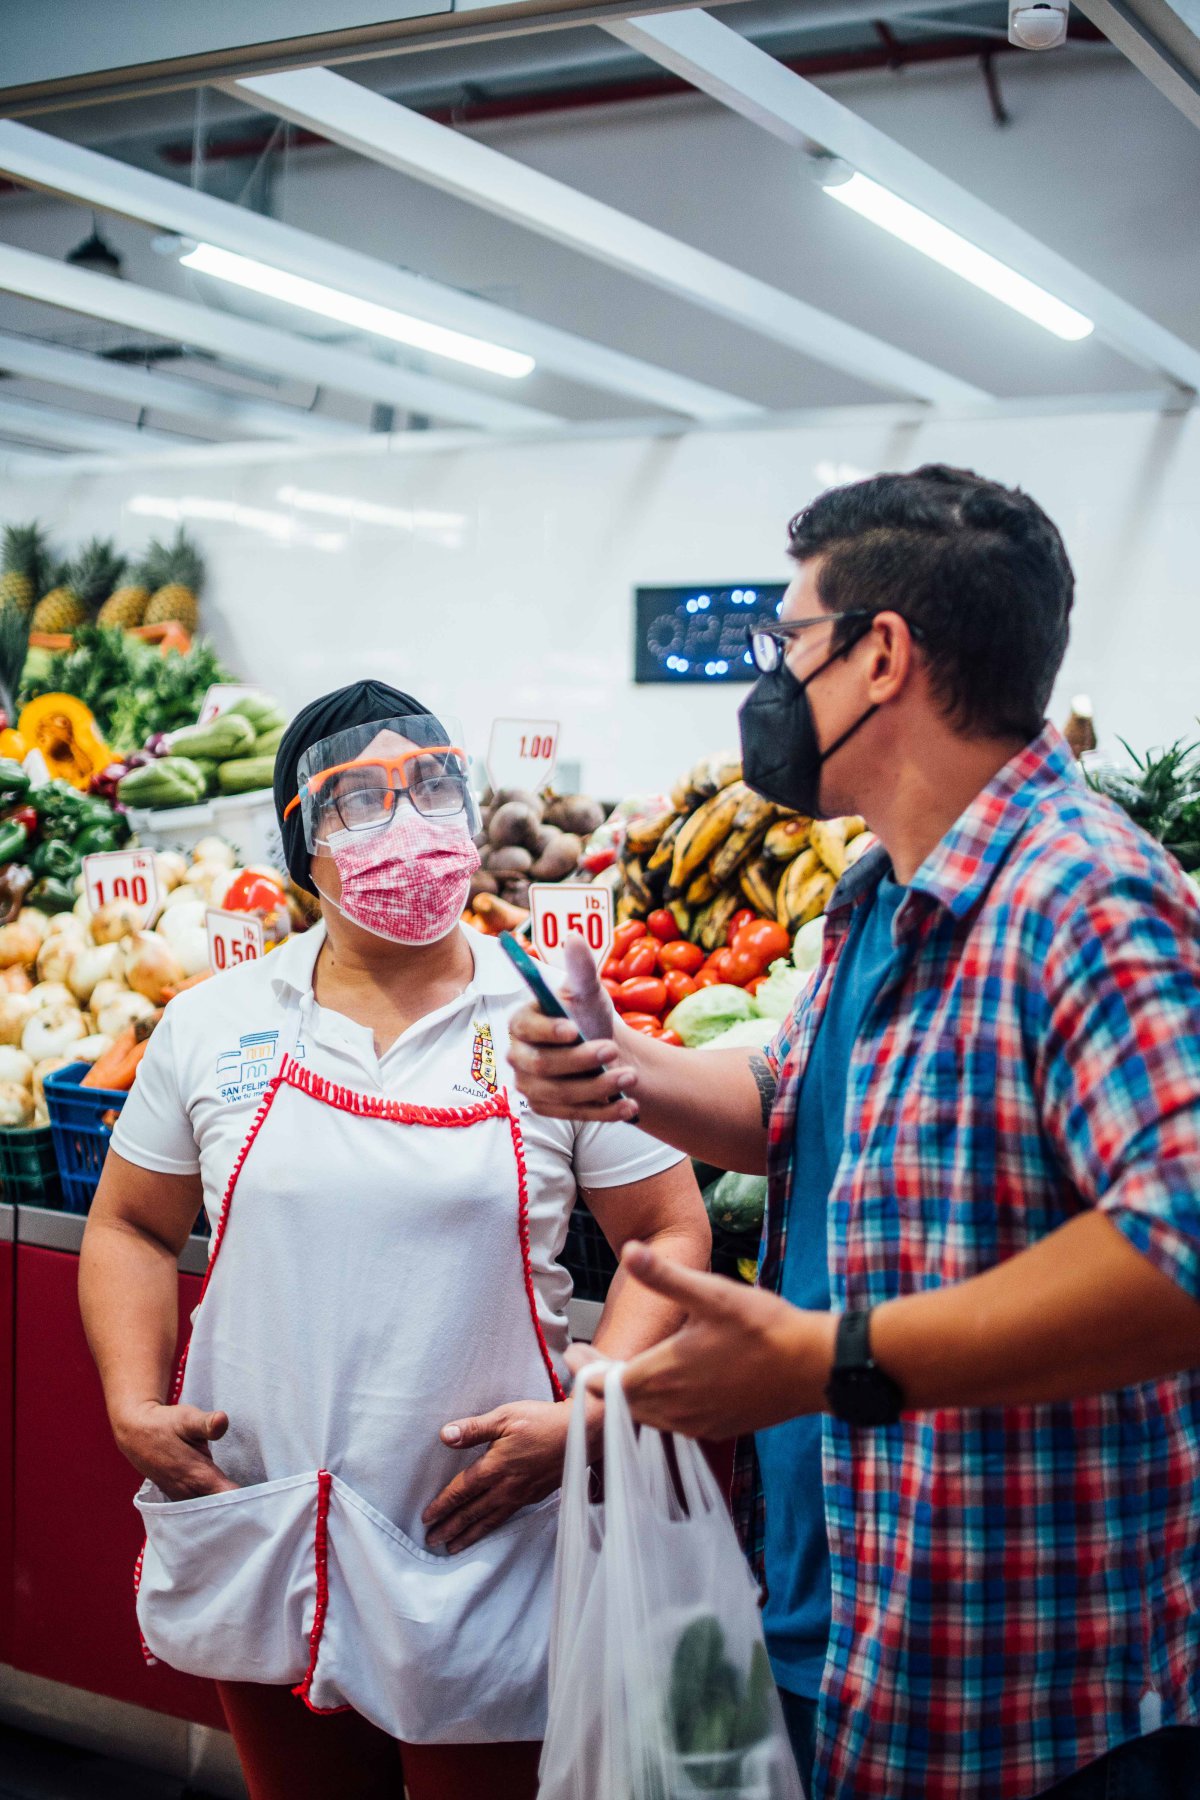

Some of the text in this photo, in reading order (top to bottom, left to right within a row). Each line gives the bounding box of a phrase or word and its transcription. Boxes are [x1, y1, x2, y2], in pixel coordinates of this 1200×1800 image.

[647, 613, 774, 658] OPE
[520, 735, 553, 758] 1.00
[585, 895, 605, 909] lb.
[543, 911, 603, 949] 0.50
[221, 1086, 239, 1098] SAN
